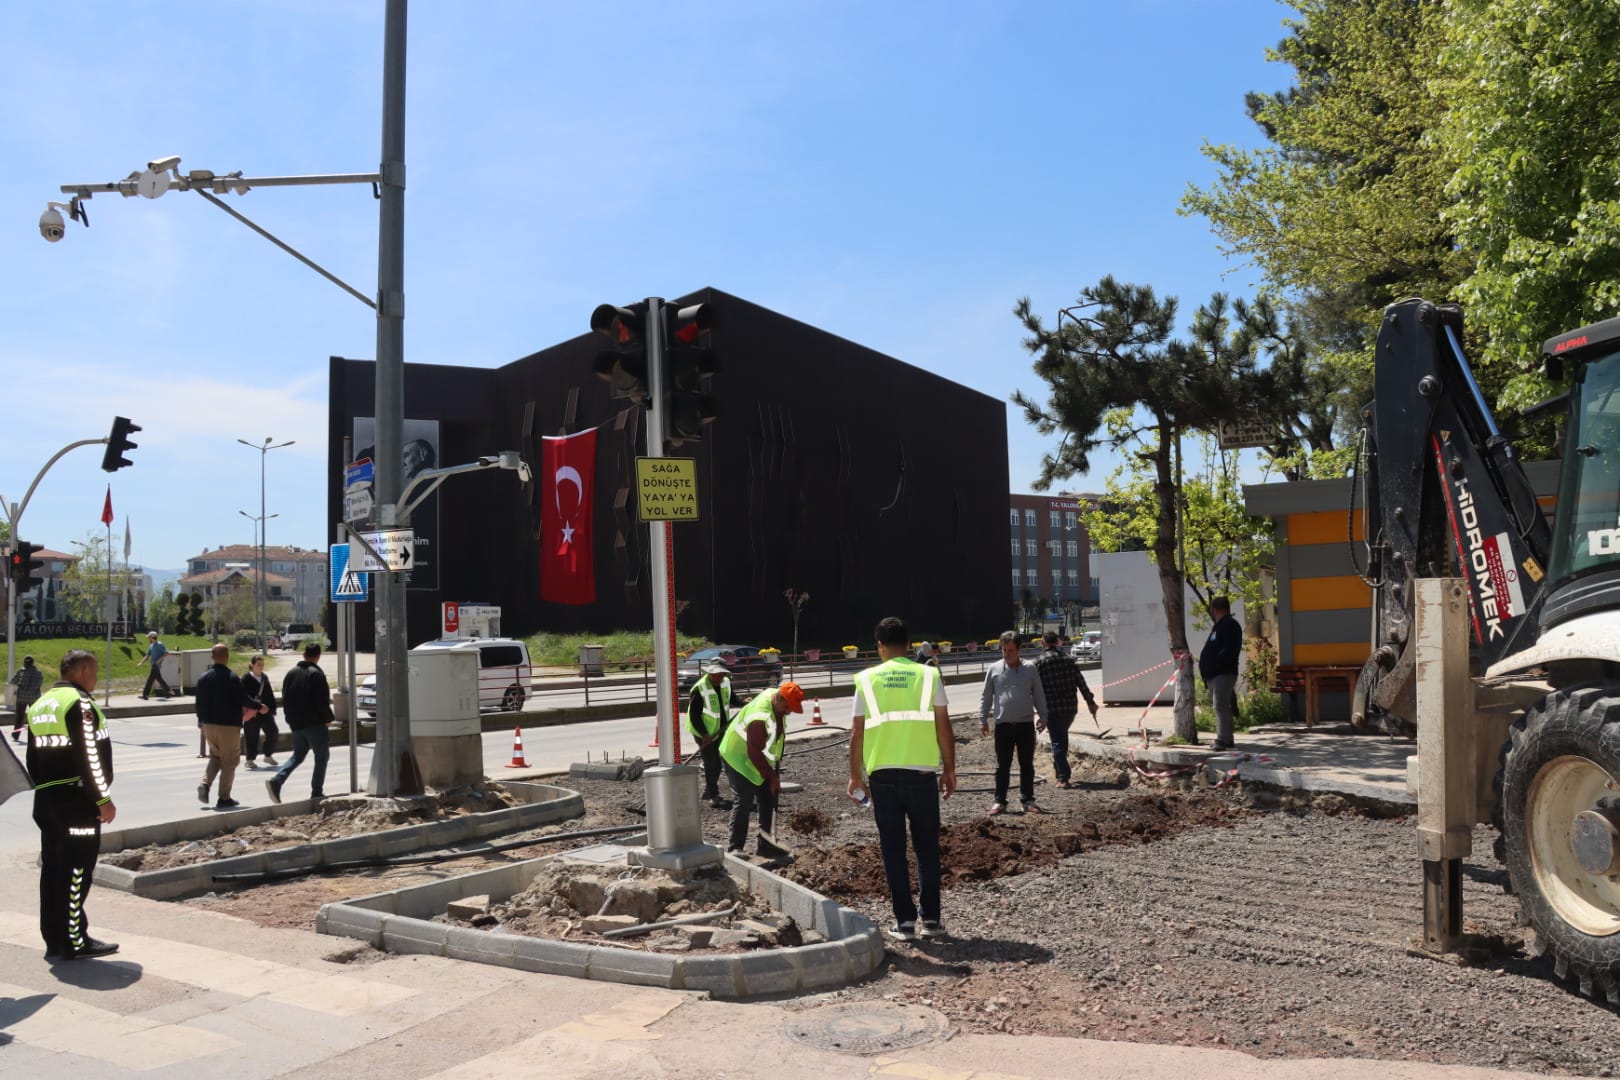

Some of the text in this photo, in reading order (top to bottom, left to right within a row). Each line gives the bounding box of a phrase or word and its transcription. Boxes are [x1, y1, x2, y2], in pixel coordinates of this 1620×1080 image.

[1554, 335, 1588, 352] ALPHA
[652, 463, 681, 473] SAĞA
[643, 476, 691, 489] DÖNÜŞTE
[646, 506, 692, 515] YOL VER
[16, 624, 63, 634] YALOVA
